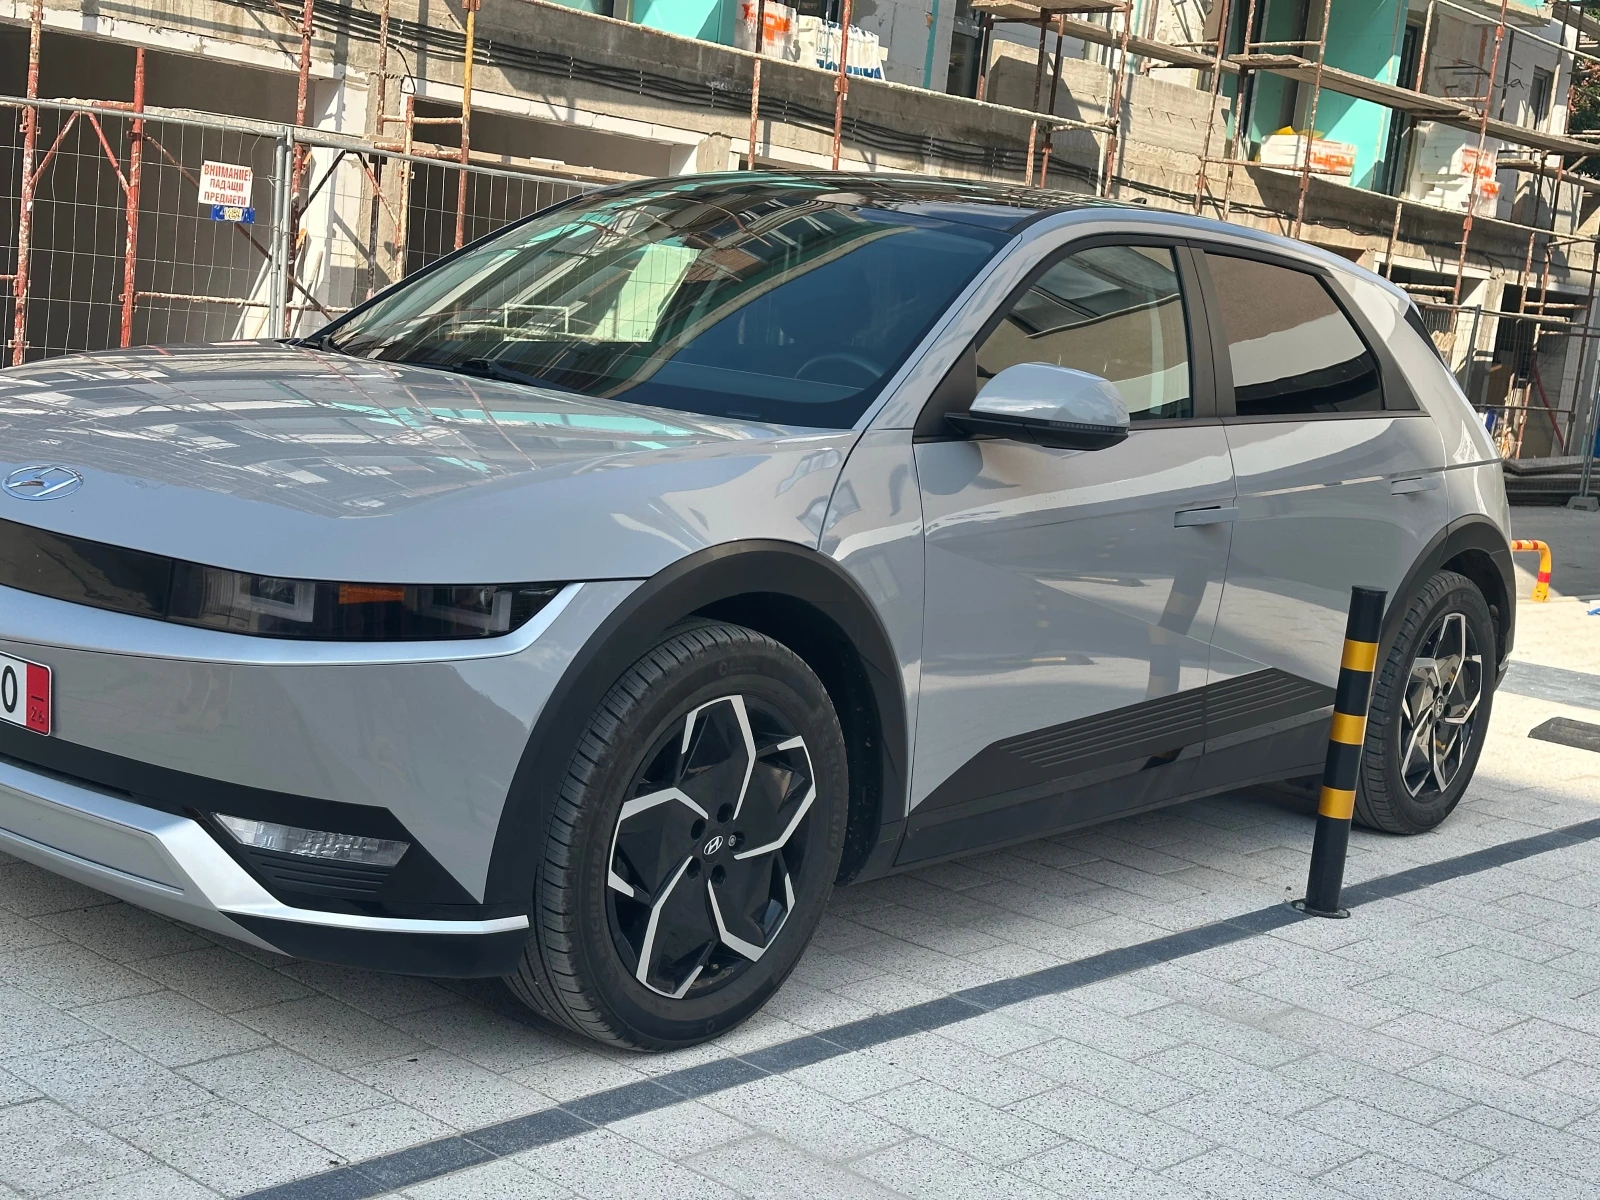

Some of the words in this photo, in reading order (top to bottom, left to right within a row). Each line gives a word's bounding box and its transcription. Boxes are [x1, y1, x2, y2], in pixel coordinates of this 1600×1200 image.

[204, 164, 251, 182] ВНИМАНИЕ!
[210, 178, 244, 193] ПАДАЩИ
[203, 191, 247, 206] ПРЕДМЕТИ
[30, 706, 45, 724] 26
[589, 847, 608, 959] MICHELIN
